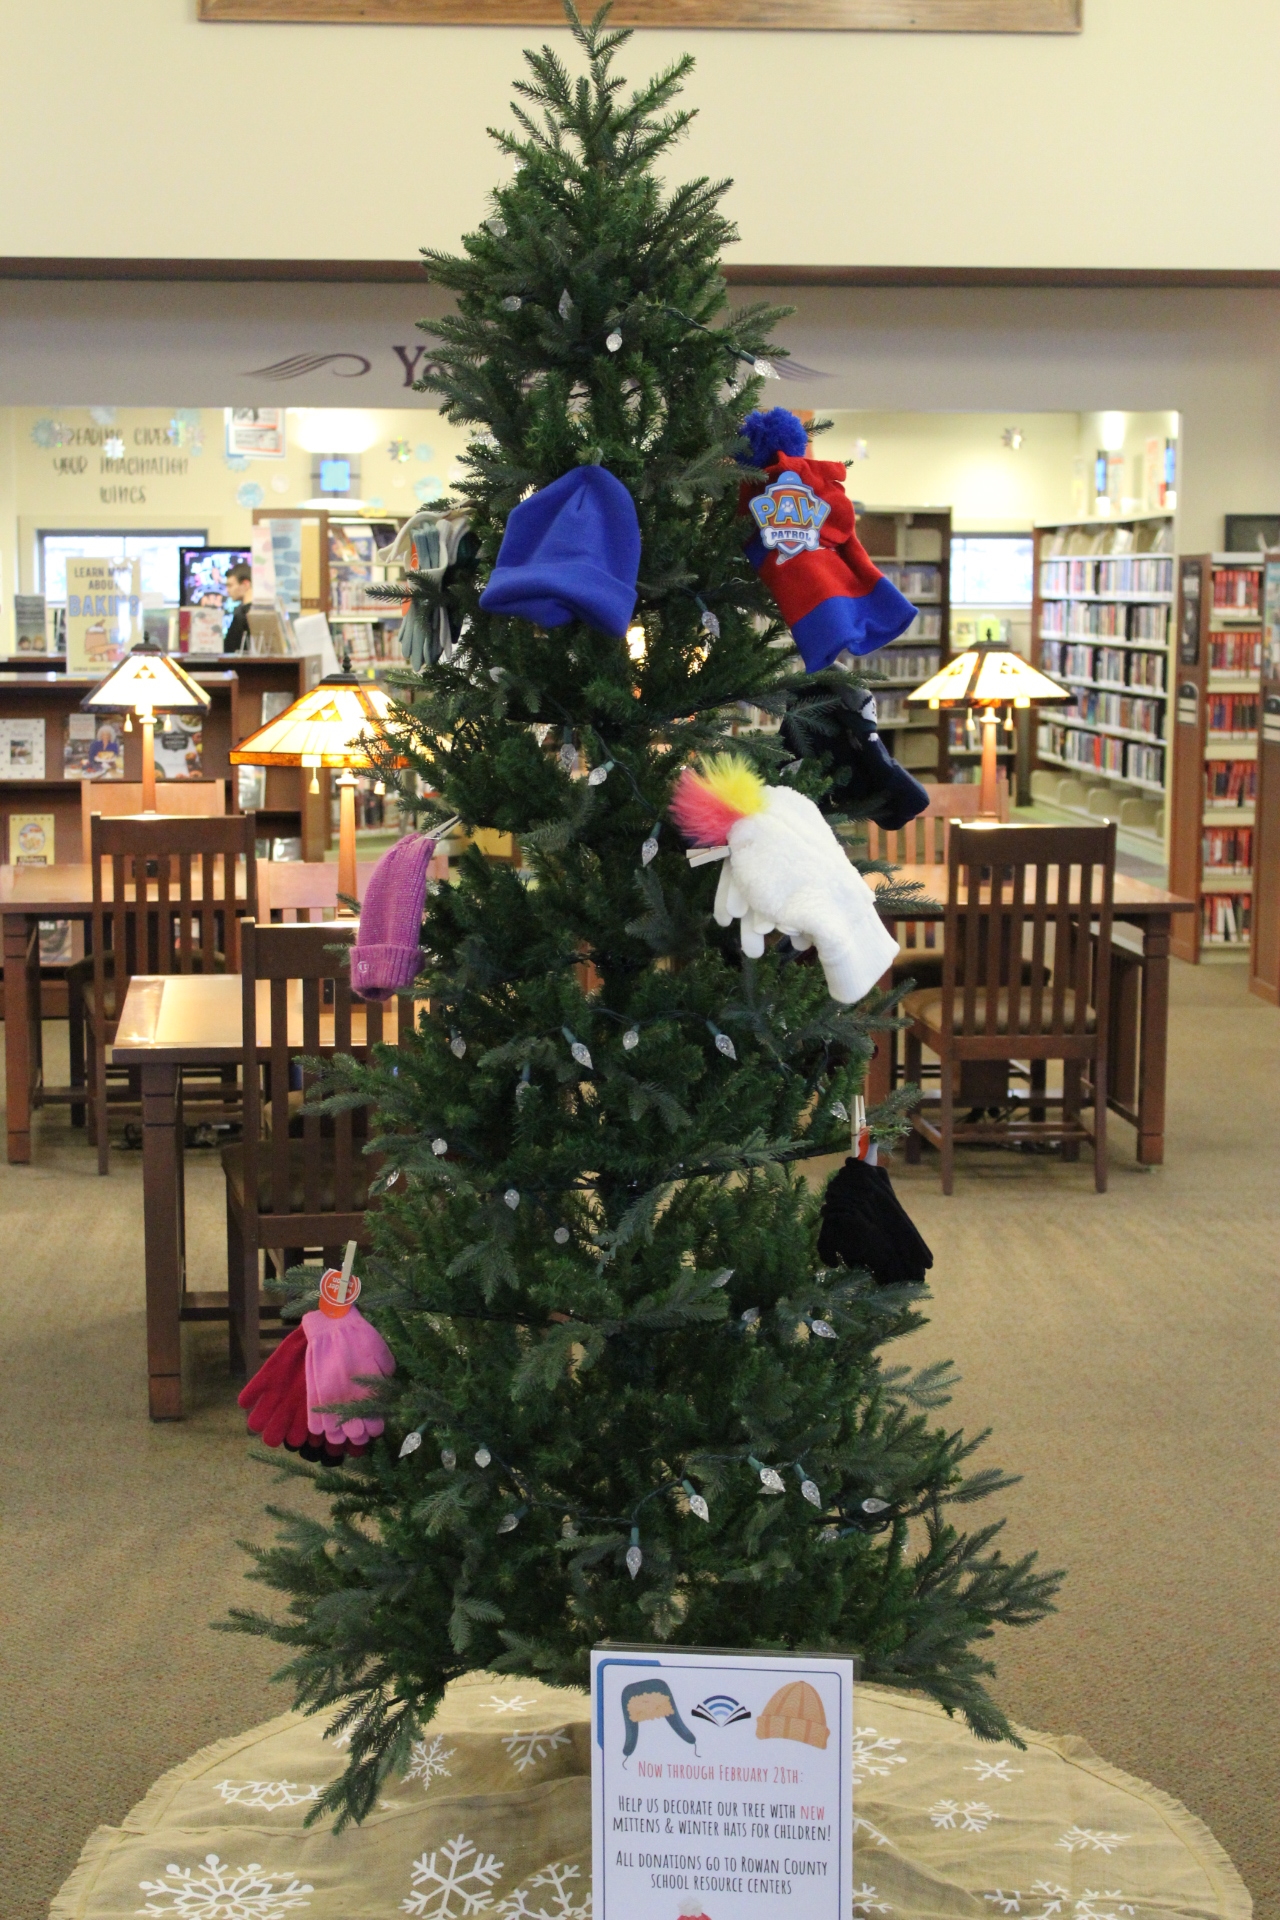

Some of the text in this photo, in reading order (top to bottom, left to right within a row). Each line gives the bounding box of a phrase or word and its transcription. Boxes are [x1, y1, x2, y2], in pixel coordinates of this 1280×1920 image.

[751, 496, 829, 529] PAW
[771, 530, 811, 541] PATROL
[74, 567, 104, 578] LEARN
[638, 1761, 804, 1784] NOW THROUGH FEBRUARY 28TH:
[618, 1796, 825, 1820] HELP US DECORATE OUR TREE WITH NEW
[613, 1817, 831, 1841] MITTENS & WINTER HATS FOR CHILDREN!
[616, 1851, 828, 1876] ALL DONATIONS GO TO ROWAN COUNTY
[651, 1873, 792, 1895] SCHOOL RESOURCE CENTERS
